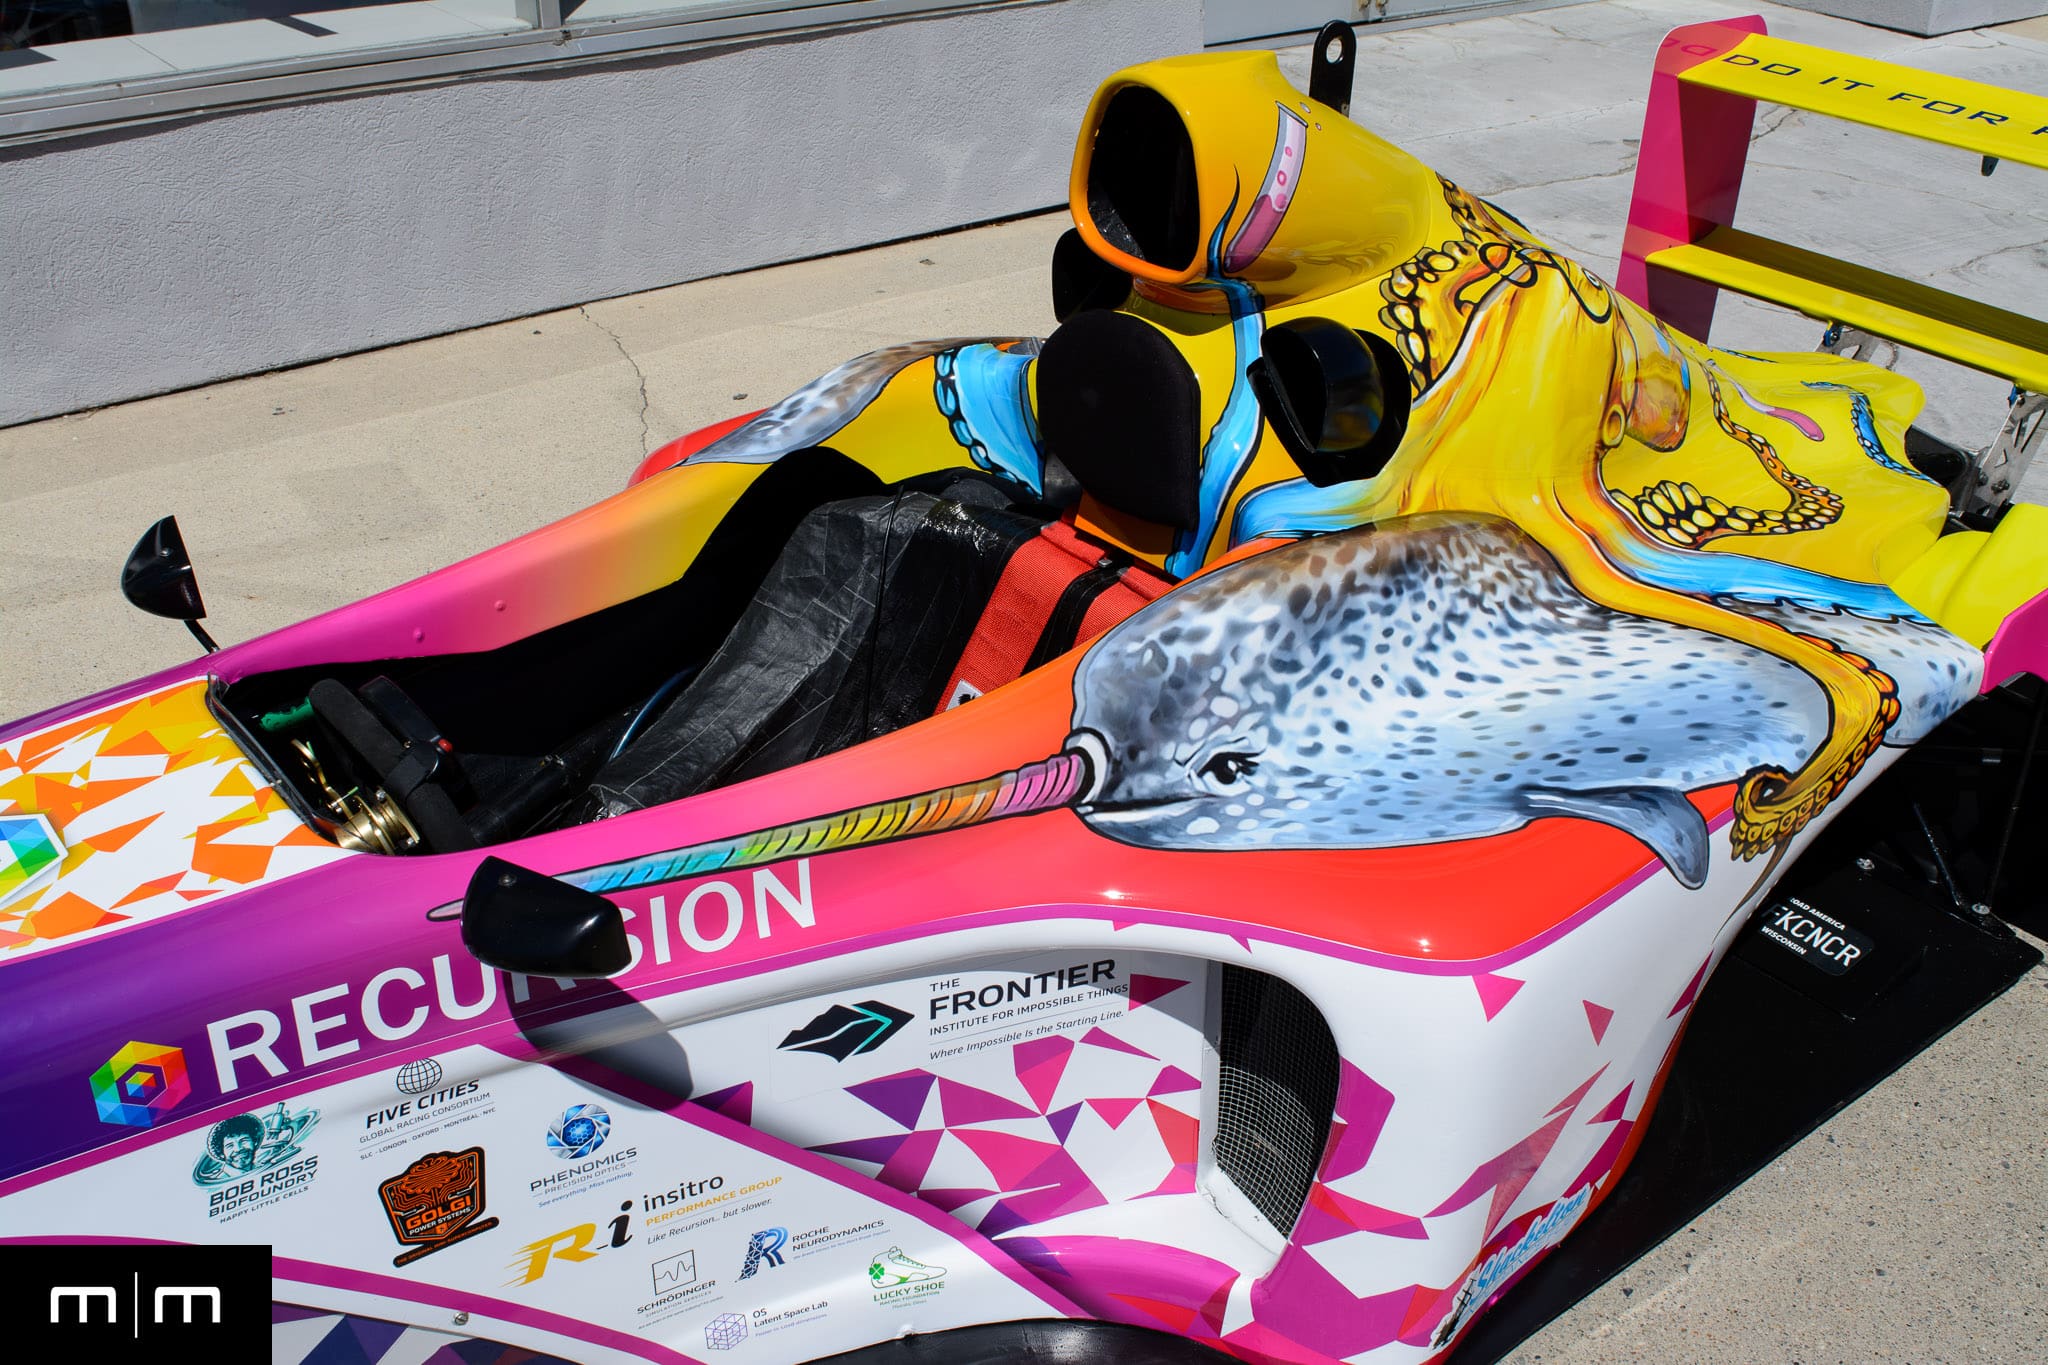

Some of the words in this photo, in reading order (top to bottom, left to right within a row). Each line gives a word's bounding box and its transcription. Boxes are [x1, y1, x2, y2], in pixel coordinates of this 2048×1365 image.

[1722, 54, 1801, 76] DO
[1819, 76, 1875, 91] IT
[1888, 92, 2009, 126] FOR
[1808, 908, 1846, 931] AMERICA
[1761, 925, 1807, 956] WISCONSIN
[930, 978, 960, 992] THE
[930, 959, 1116, 1020] FRONTIER
[930, 1015, 989, 1036] INSTITUTE
[992, 1009, 1014, 1022] FOR
[1017, 993, 1084, 1016] IMPOSSIBLE
[1087, 983, 1129, 1000] THINGS
[930, 1044, 964, 1061] Where
[966, 1030, 1023, 1052] Impossible
[1025, 1028, 1034, 1038] Is
[1036, 1023, 1053, 1036] the
[1055, 1014, 1097, 1032] Starting
[1100, 1008, 1125, 1022] Line.
[360, 1126, 395, 1144] GLOBAL
[397, 1112, 430, 1130] RACING
[432, 1092, 490, 1117] CONSORTIUM
[367, 1101, 411, 1129] FIVE
[418, 1079, 479, 1110] CITIES
[379, 1138, 407, 1153] LONDON
[412, 1126, 439, 1141] OXFORD
[483, 1106, 497, 1116] NYC
[209, 1180, 255, 1207] BOB
[261, 1155, 318, 1187] ROSS
[530, 1147, 638, 1192] PHENOMICS
[545, 1174, 593, 1194] PRECISION
[595, 1162, 626, 1177] OPTICS
[209, 1169, 318, 1218] BIOFOUNDRY
[220, 1207, 249, 1224] HAPPY
[252, 1196, 280, 1212] LITTLE
[283, 1185, 309, 1200] CELLS
[406, 1195, 471, 1230] GOLGI
[643, 1174, 724, 1213] insitro
[646, 1190, 736, 1227] PERFORMANCE
[740, 1176, 783, 1195] GROUP
[409, 1220, 437, 1236] POWER
[437, 1205, 471, 1225] SYSTEMS
[647, 1232, 667, 1245] Like
[722, 1207, 740, 1219] but
[741, 1198, 773, 1213] slower.
[792, 1226, 830, 1243] ROCHE
[792, 1219, 885, 1252] NEURODYNAMICS
[637, 1280, 716, 1314] SCHRÖDINGER
[873, 1287, 912, 1302] LUCKY
[914, 1281, 945, 1294] SHOE
[752, 1308, 767, 1320] OS
[753, 1314, 782, 1328] Latent
[783, 1307, 810, 1320] Space
[811, 1300, 828, 1312] Lab
